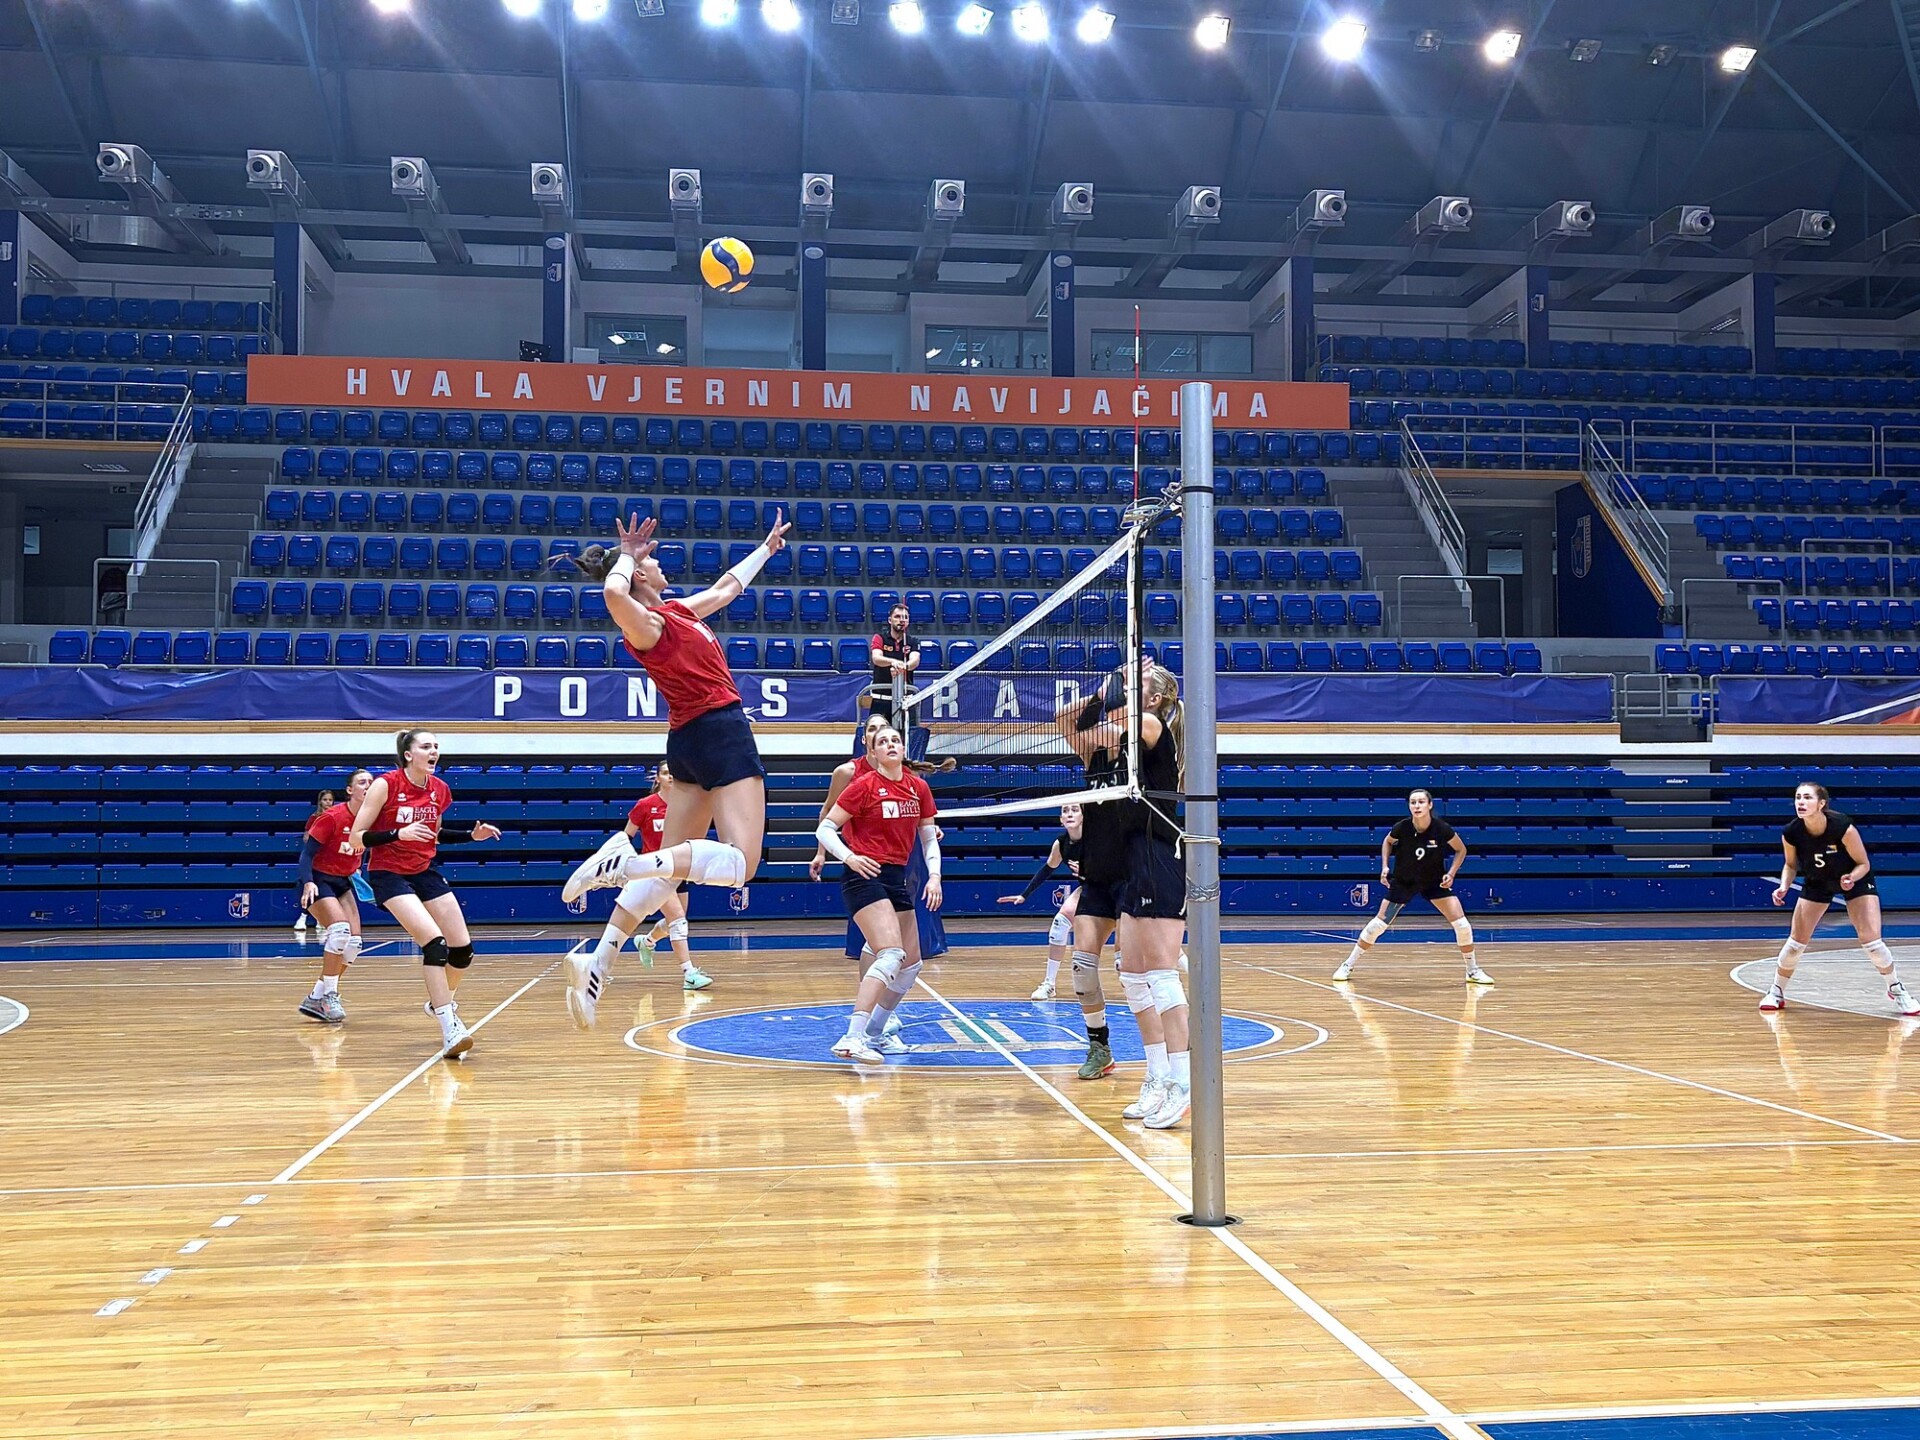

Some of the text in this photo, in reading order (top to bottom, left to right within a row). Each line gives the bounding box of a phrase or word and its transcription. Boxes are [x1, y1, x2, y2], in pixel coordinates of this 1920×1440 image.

[346, 368, 1268, 418] HVALA VJERNIM NAVIJAČIMA
[494, 676, 788, 717] PONS
[1415, 847, 1425, 860] 9
[1814, 853, 1825, 868] 5
